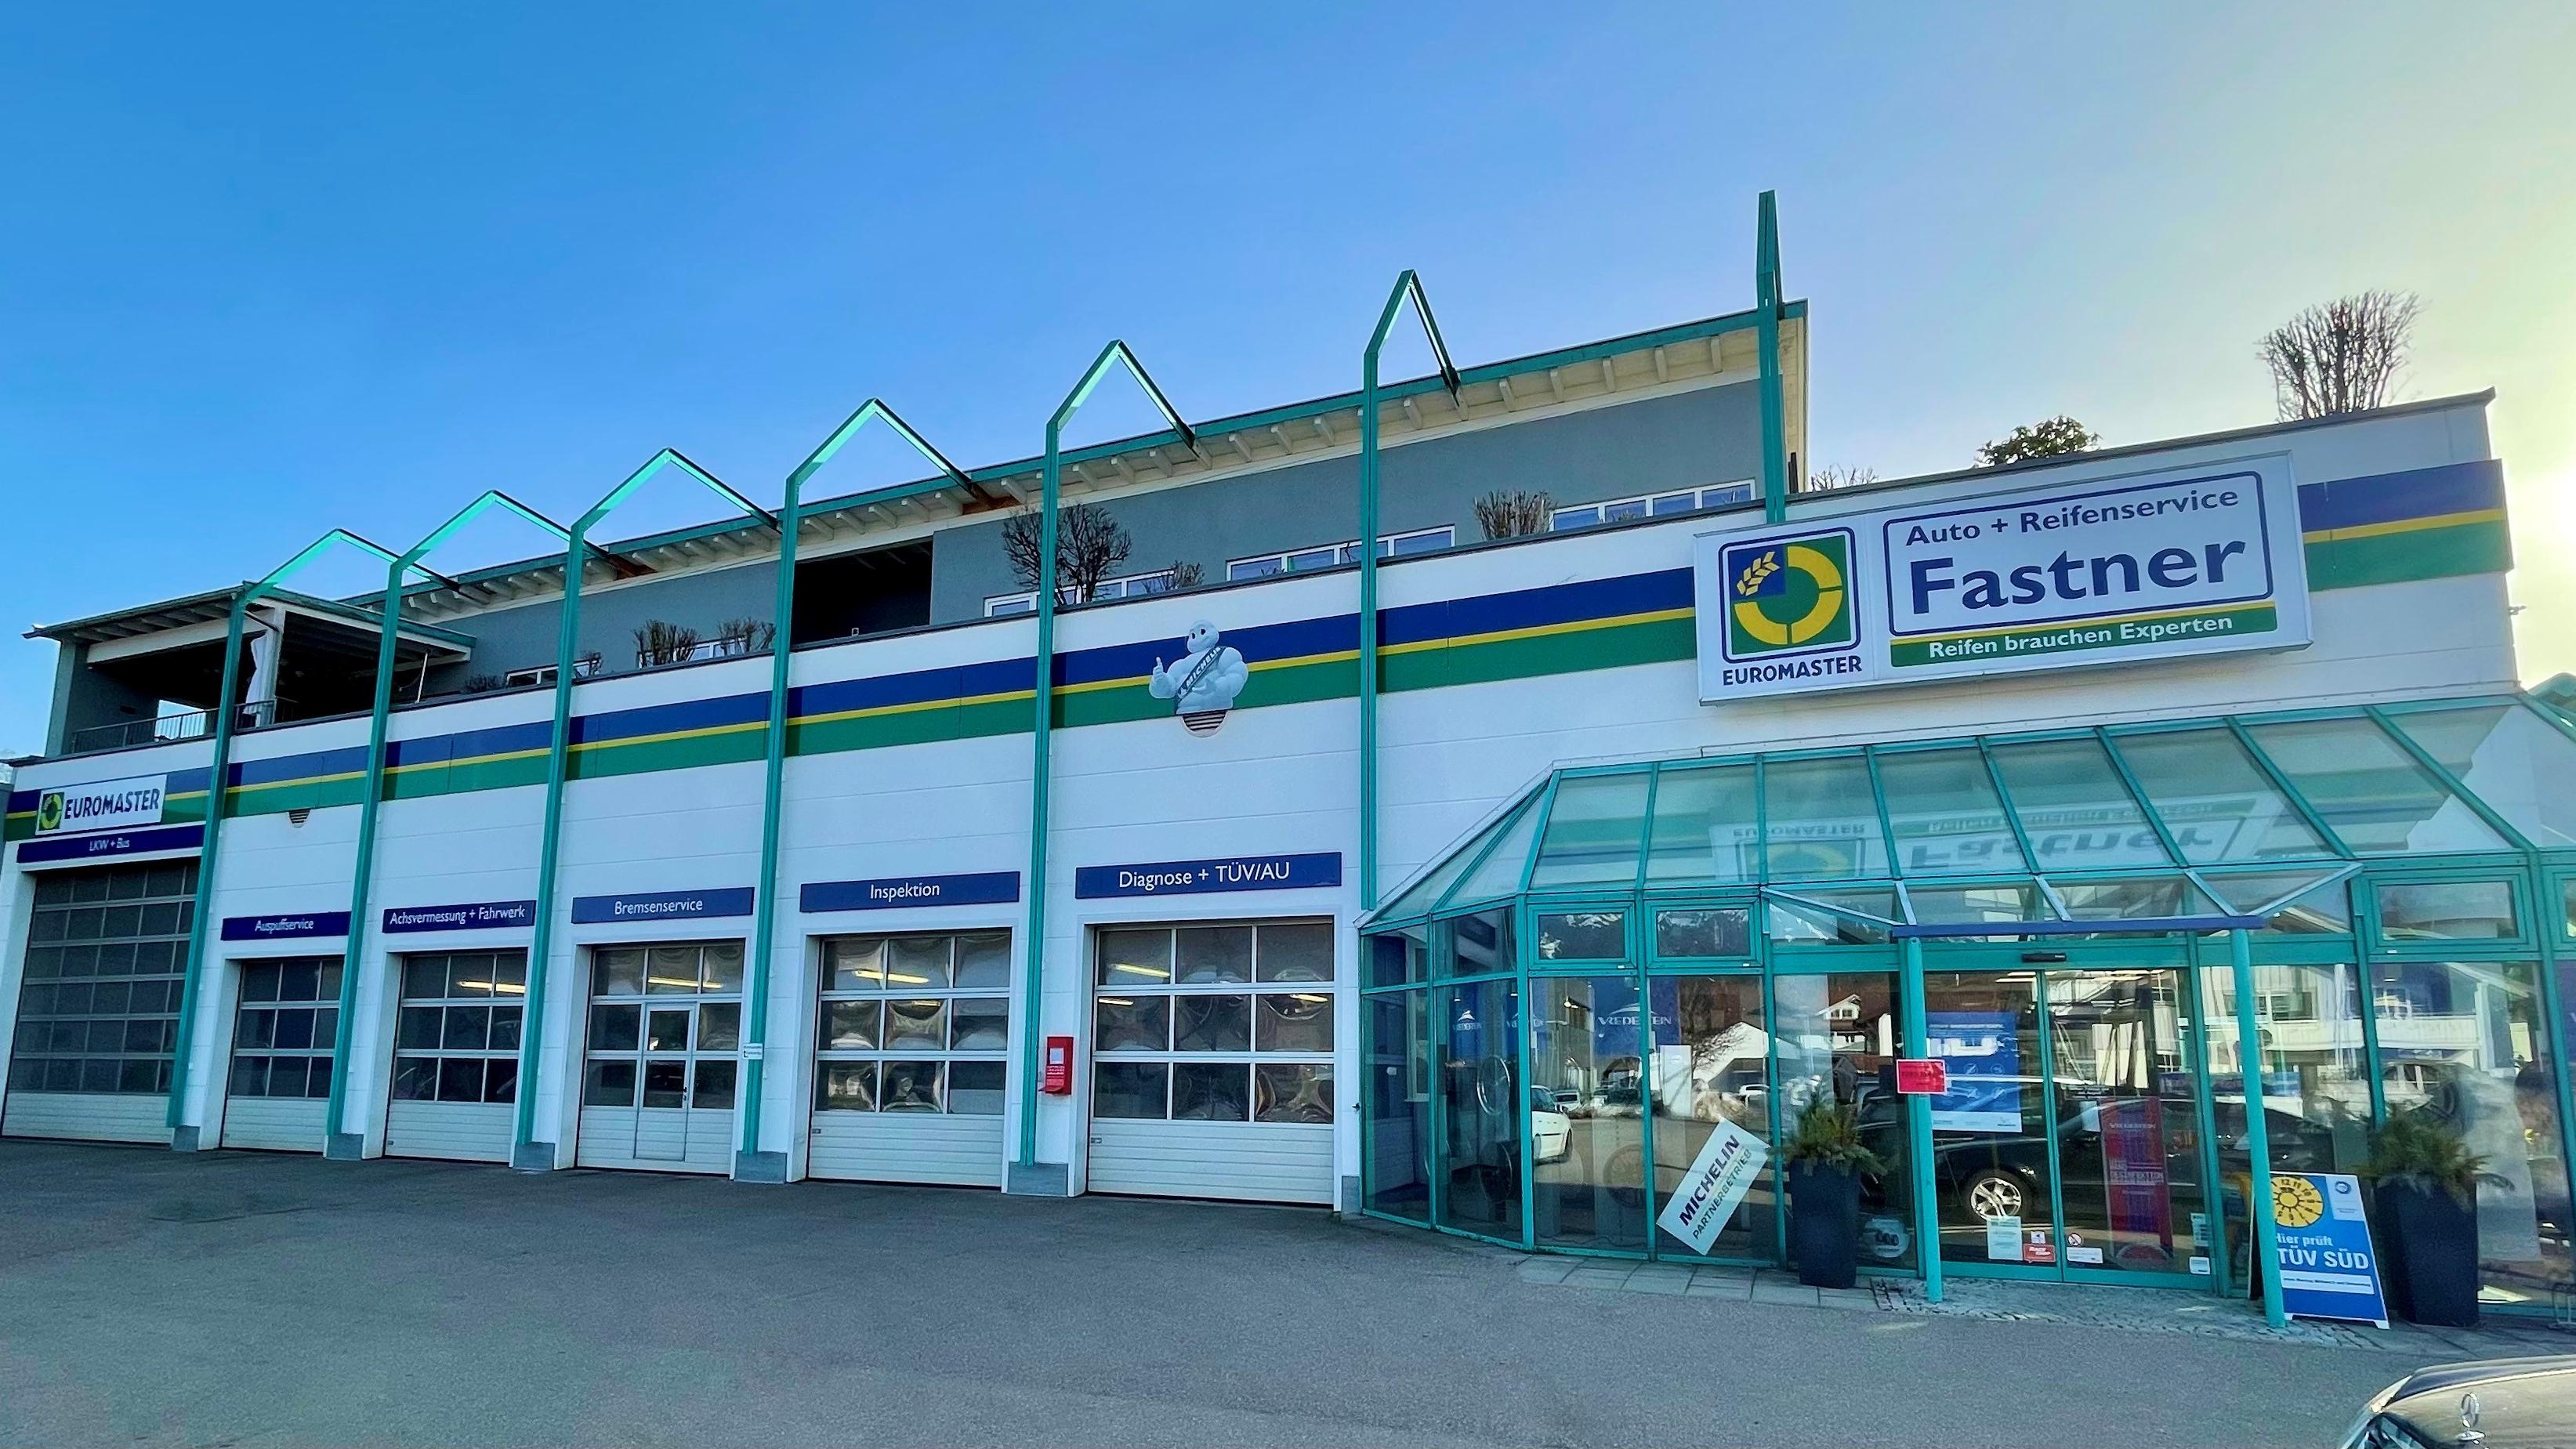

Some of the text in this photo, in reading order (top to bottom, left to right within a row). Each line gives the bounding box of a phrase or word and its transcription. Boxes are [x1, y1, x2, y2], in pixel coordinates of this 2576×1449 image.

[1906, 489, 2239, 547] Auto + Reifenservice
[1910, 540, 2246, 614] Fastner
[1929, 615, 2234, 658] Reifen brauchen Experten
[1723, 654, 1862, 686] EUROMASTER
[63, 788, 161, 820] EUROMASTER
[1119, 861, 1290, 891] Diagnose + TÜV/AU
[614, 897, 703, 915] Bremsenservice
[869, 882, 940, 903] Inspektion
[389, 904, 527, 925] Achsvermessung + Fahrwerk
[1679, 1134, 1740, 1226] MICHELIN
[1692, 1148, 1752, 1240] PARTNERBETRIEB
[2302, 1233, 2333, 1248] prüft
[2277, 1244, 2370, 1270] TÜV SÜD
